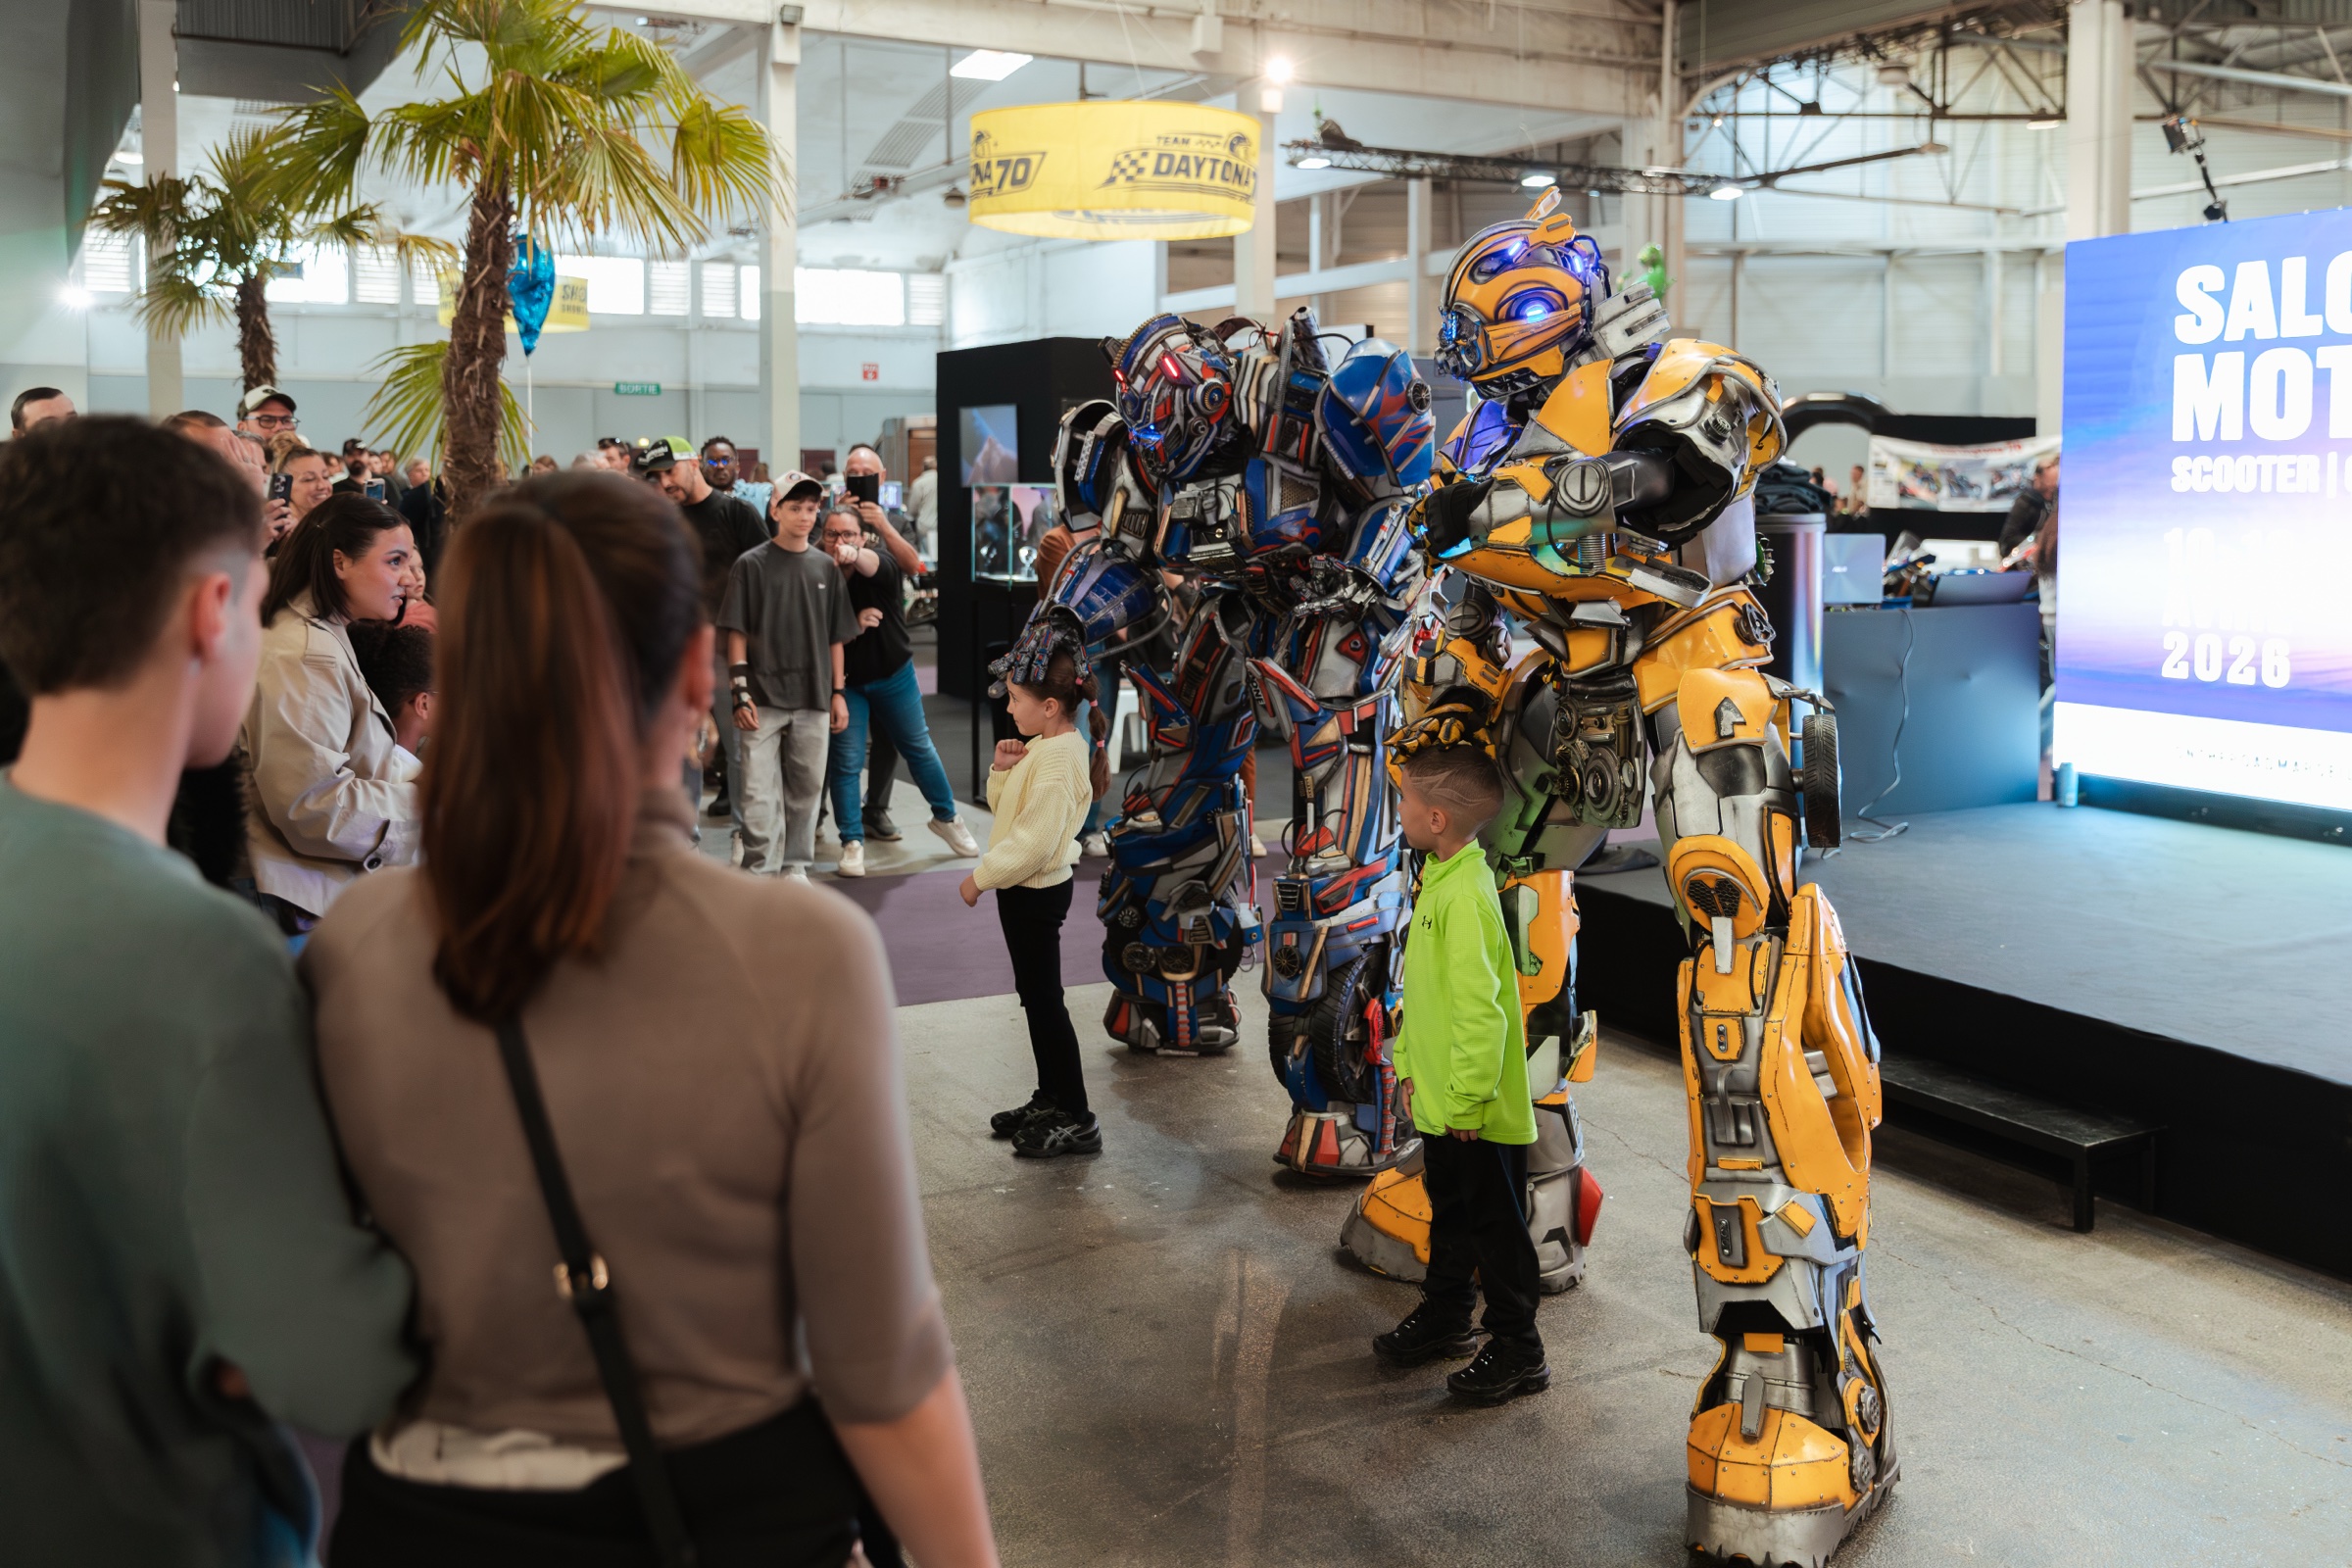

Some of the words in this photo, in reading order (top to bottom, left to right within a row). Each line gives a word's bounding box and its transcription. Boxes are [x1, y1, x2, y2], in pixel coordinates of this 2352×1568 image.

[1156, 135, 1191, 146] TEAM
[996, 158, 1032, 190] 70
[618, 383, 658, 395] SORTIE
[2171, 454, 2321, 493] SCOOTER
[2161, 630, 2291, 689] 2026
